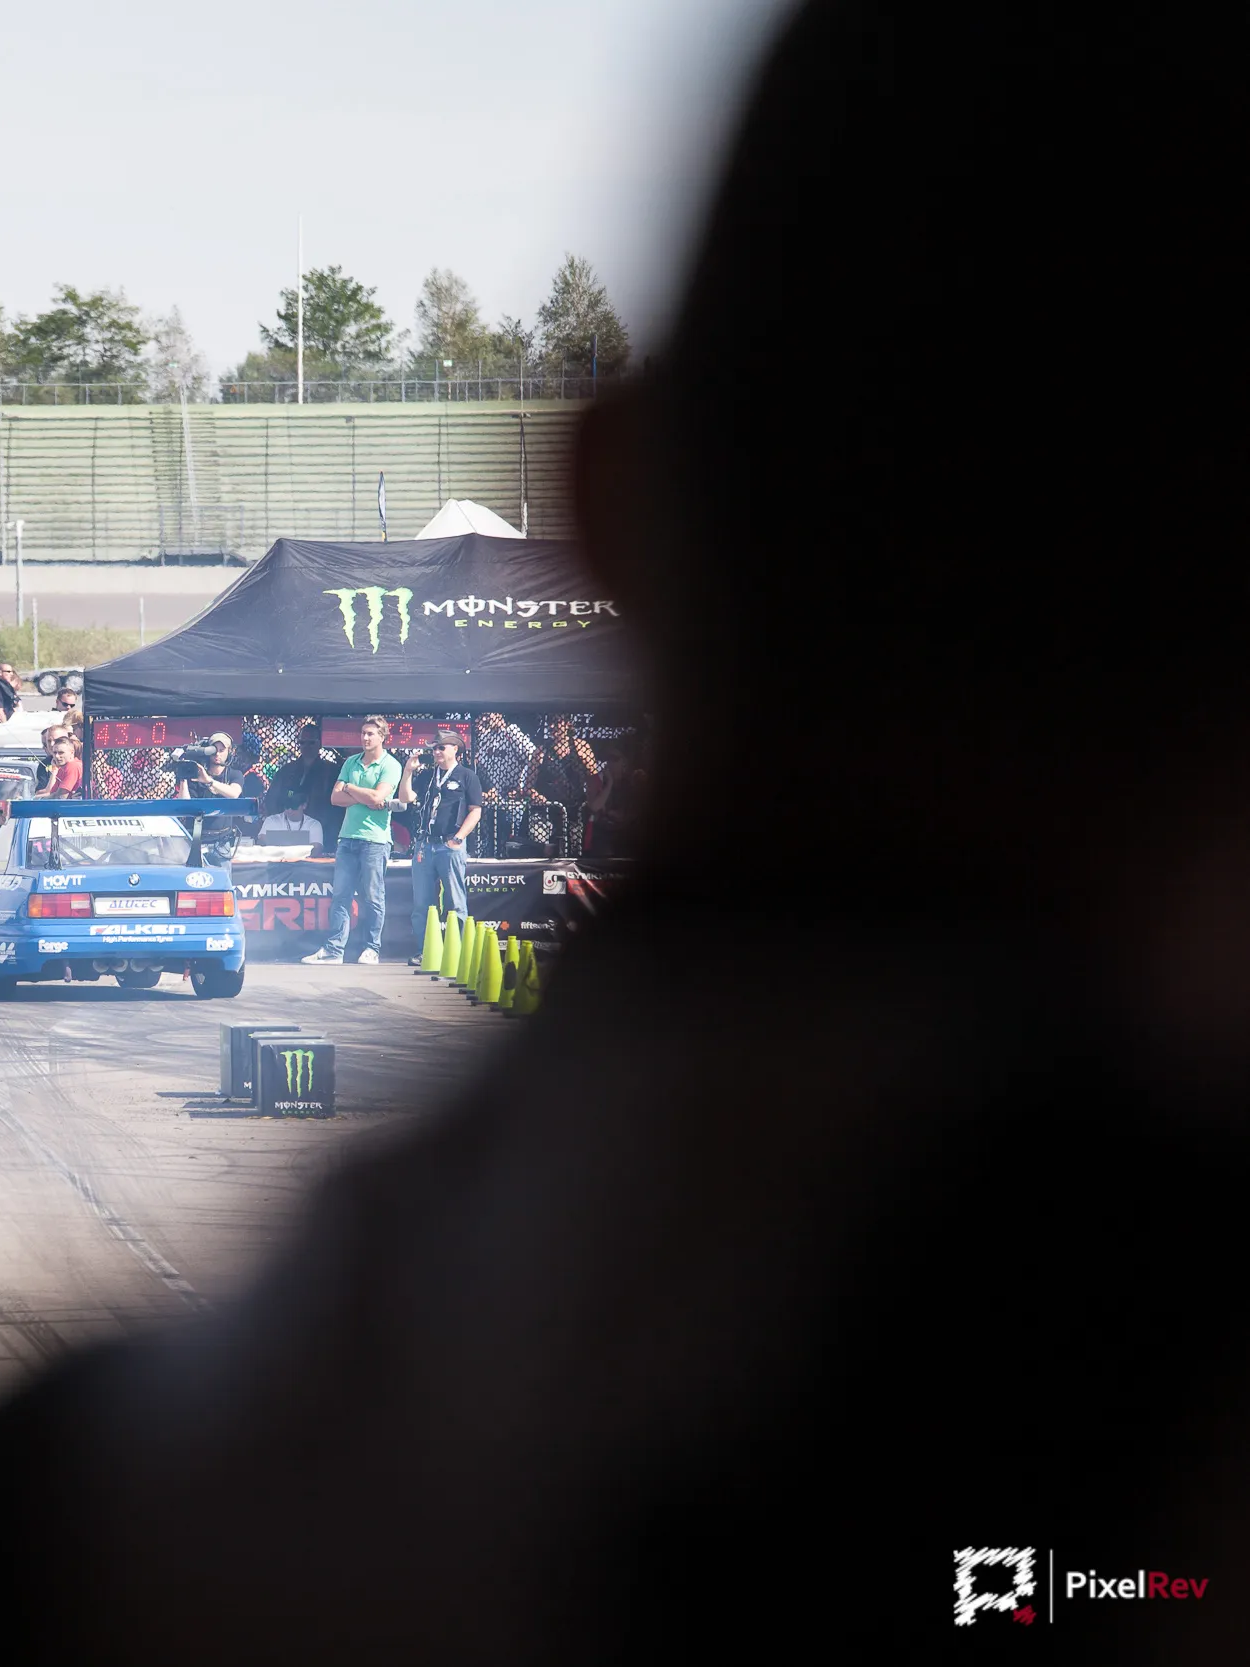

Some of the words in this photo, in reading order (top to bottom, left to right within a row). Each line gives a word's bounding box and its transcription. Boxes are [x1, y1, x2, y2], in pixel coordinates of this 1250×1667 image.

[422, 595, 621, 617] MONSTER
[454, 619, 591, 629] ENERGY
[109, 899, 158, 909] ALUTEC
[90, 924, 186, 935] FALKEN
[38, 940, 68, 953] Forge
[274, 1101, 323, 1110] MONSTER
